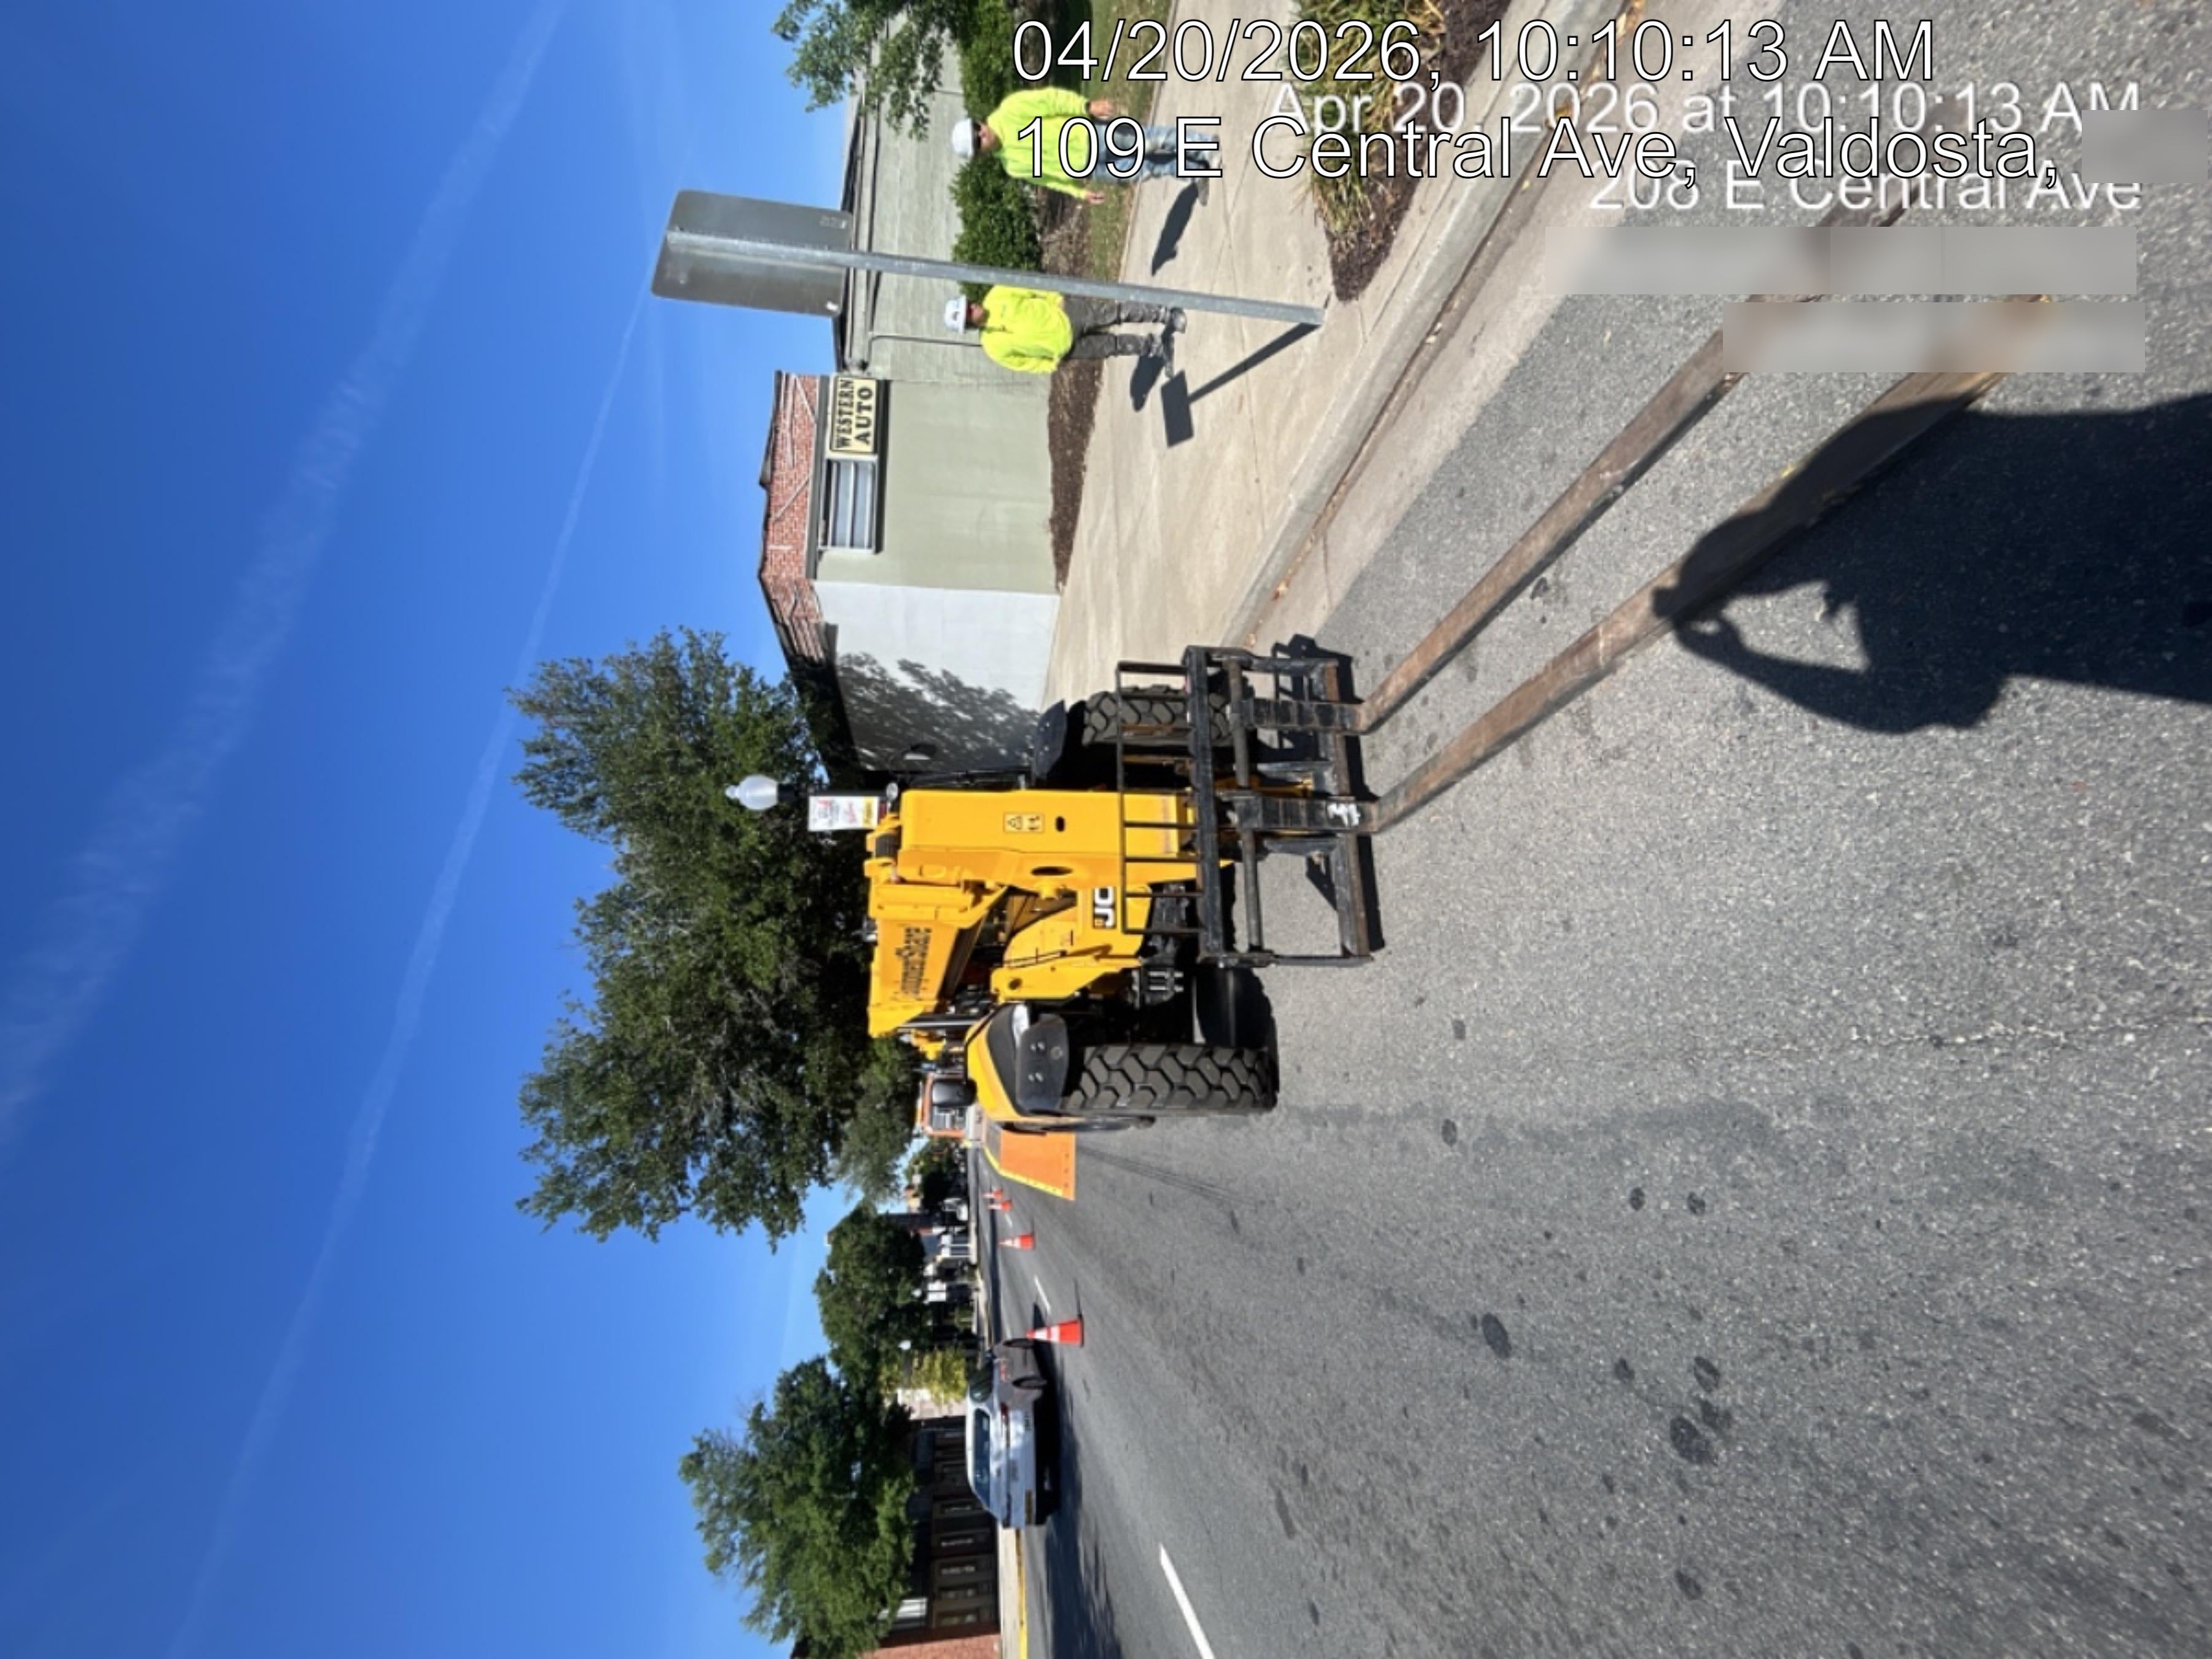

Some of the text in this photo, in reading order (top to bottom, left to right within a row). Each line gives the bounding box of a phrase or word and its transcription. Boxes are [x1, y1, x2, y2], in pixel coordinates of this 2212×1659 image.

[836, 378, 854, 449] WESTERN
[855, 386, 873, 445] AUTO
[1094, 886, 1114, 927] JC
